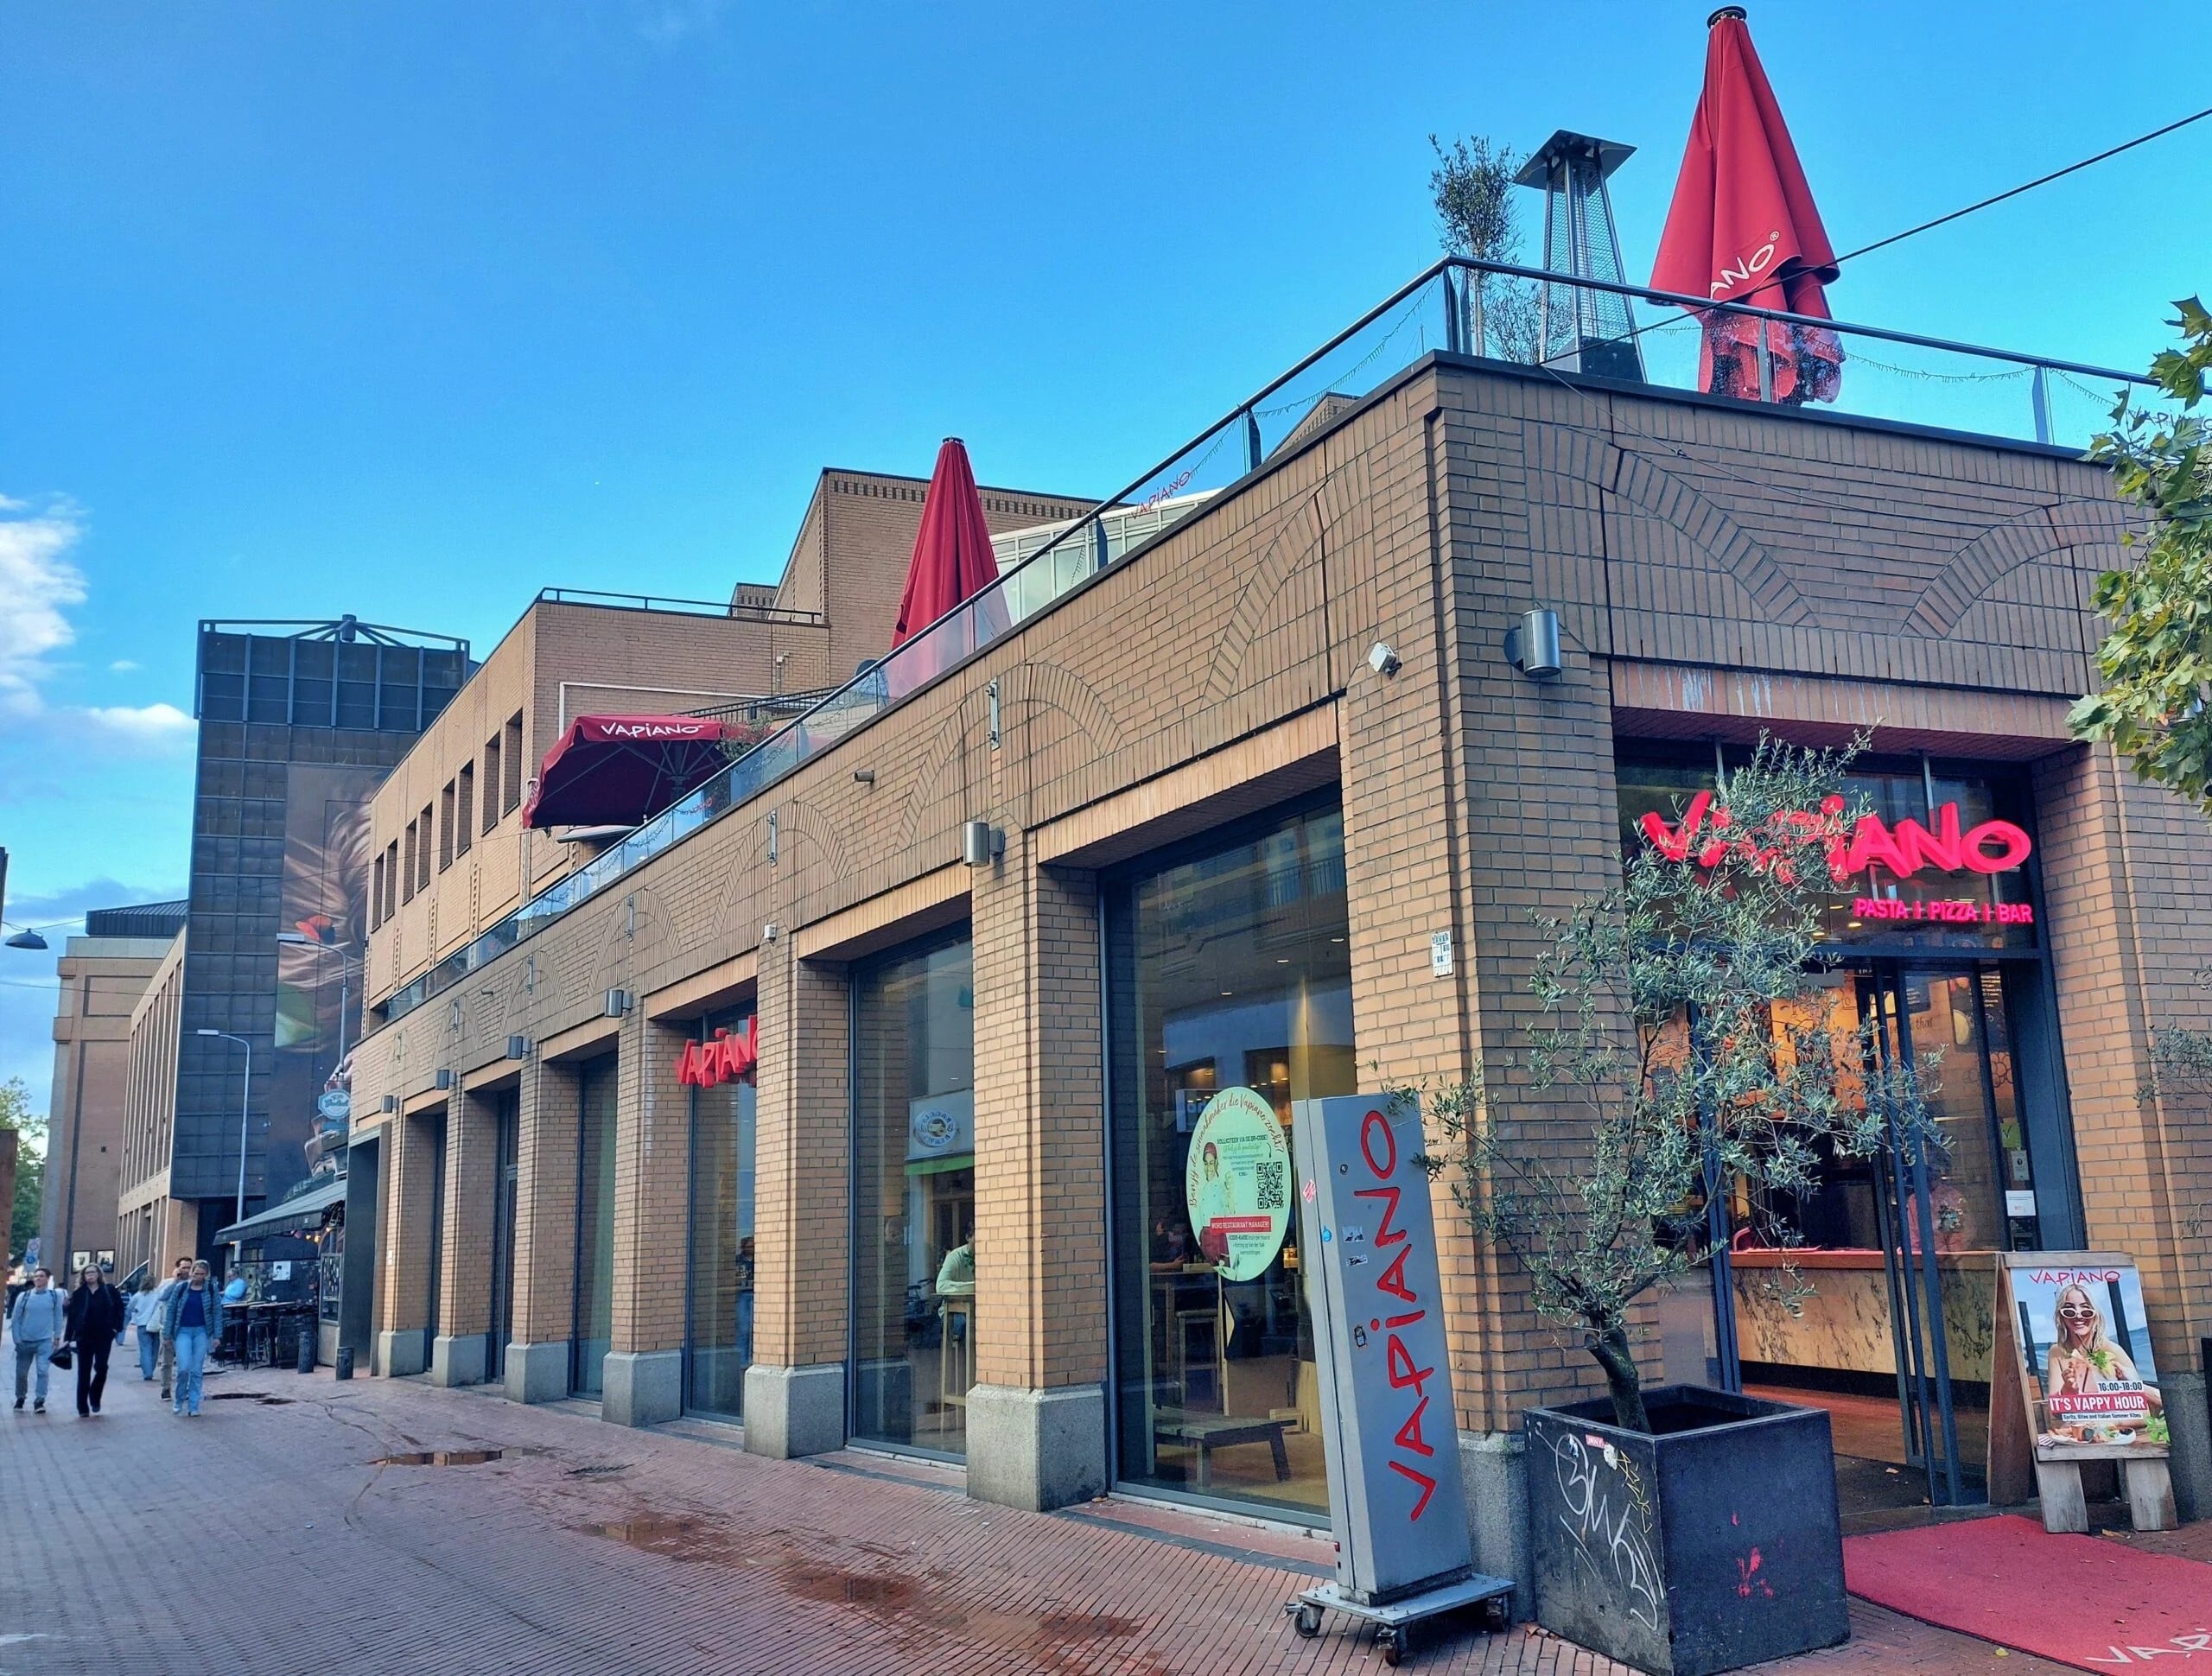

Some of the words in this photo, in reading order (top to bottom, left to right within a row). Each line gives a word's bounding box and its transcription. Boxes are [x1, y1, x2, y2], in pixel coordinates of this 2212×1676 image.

[1854, 898, 1908, 920] PASTA
[1928, 900, 1978, 922] PIZZA
[1997, 902, 2034, 924] BAR
[1228, 1092, 1239, 1107] die
[1240, 1093, 1266, 1121] Vapiano
[2099, 1382, 2142, 1392] 16:00-18:00
[2050, 1398, 2071, 1411] IT'S
[2074, 1397, 2111, 1410] VAPPY
[2114, 1396, 2145, 1410] HOUR
